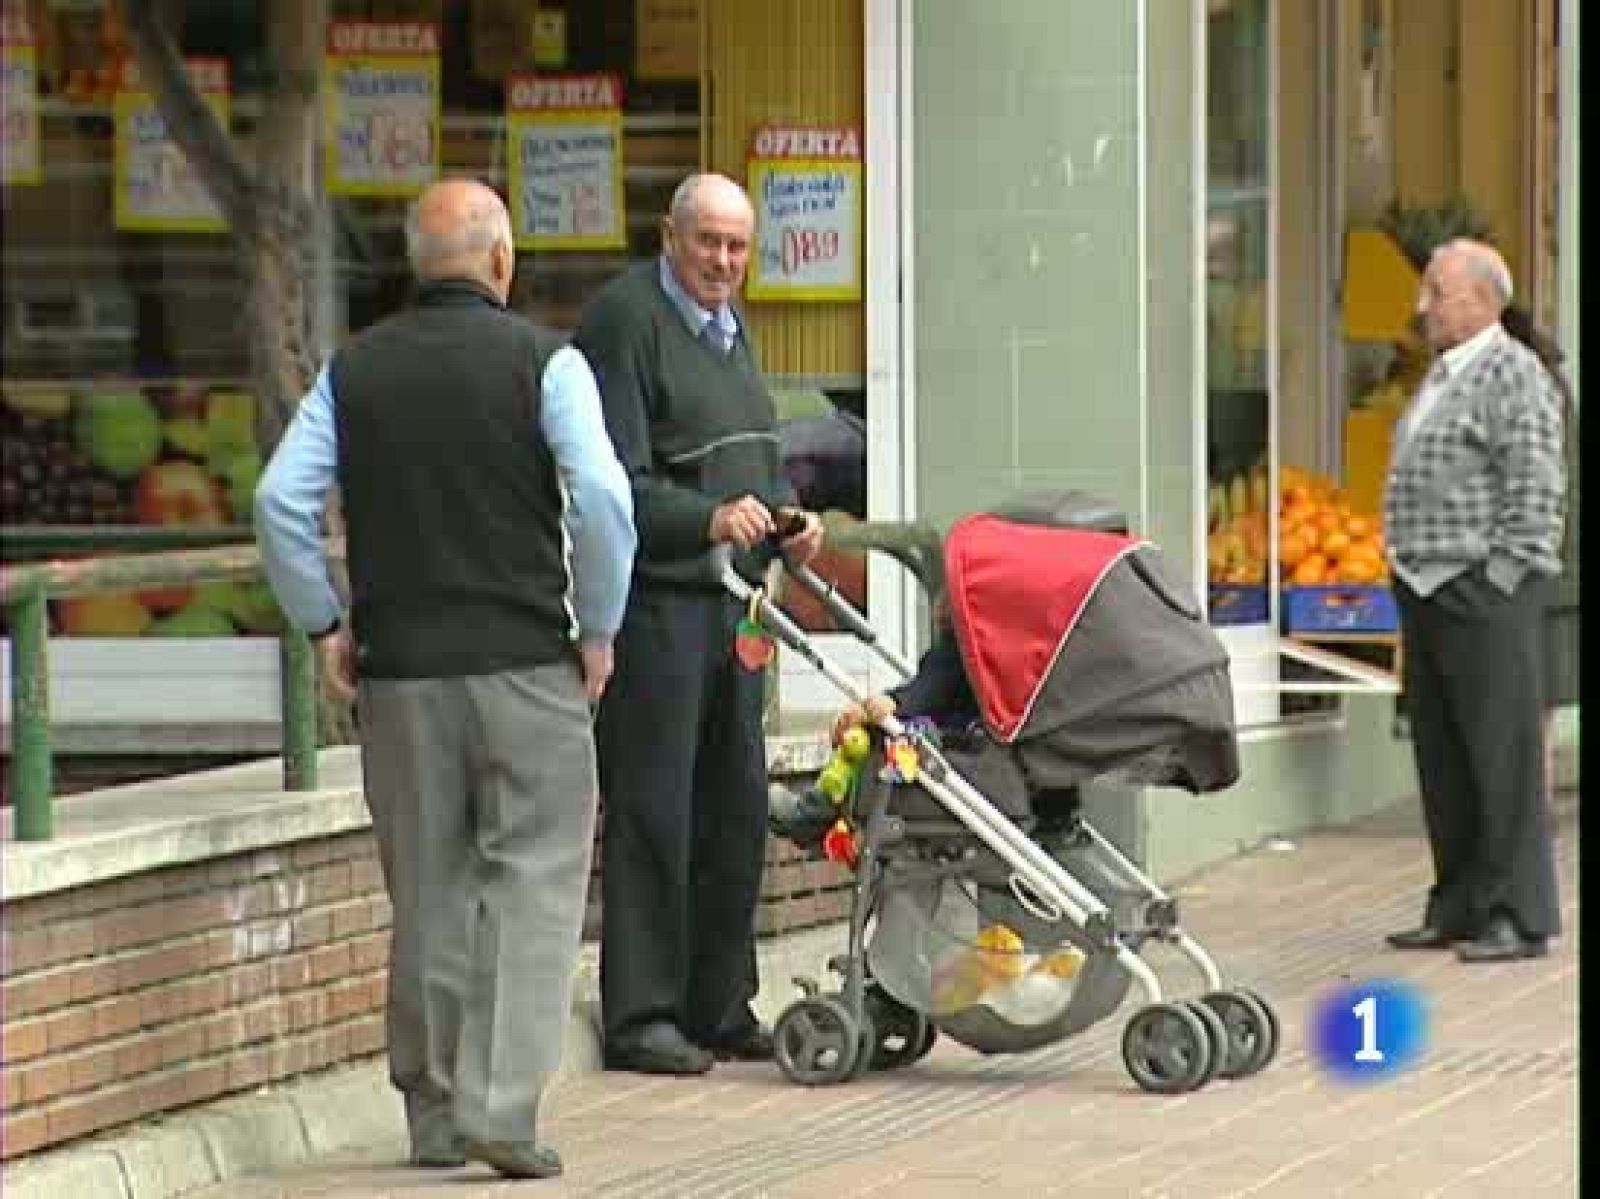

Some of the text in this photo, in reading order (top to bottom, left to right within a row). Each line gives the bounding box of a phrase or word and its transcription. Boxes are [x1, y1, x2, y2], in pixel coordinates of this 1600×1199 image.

[333, 23, 435, 48] OFERTA
[511, 79, 612, 107] OFERTA
[754, 128, 859, 156] OFERTA
